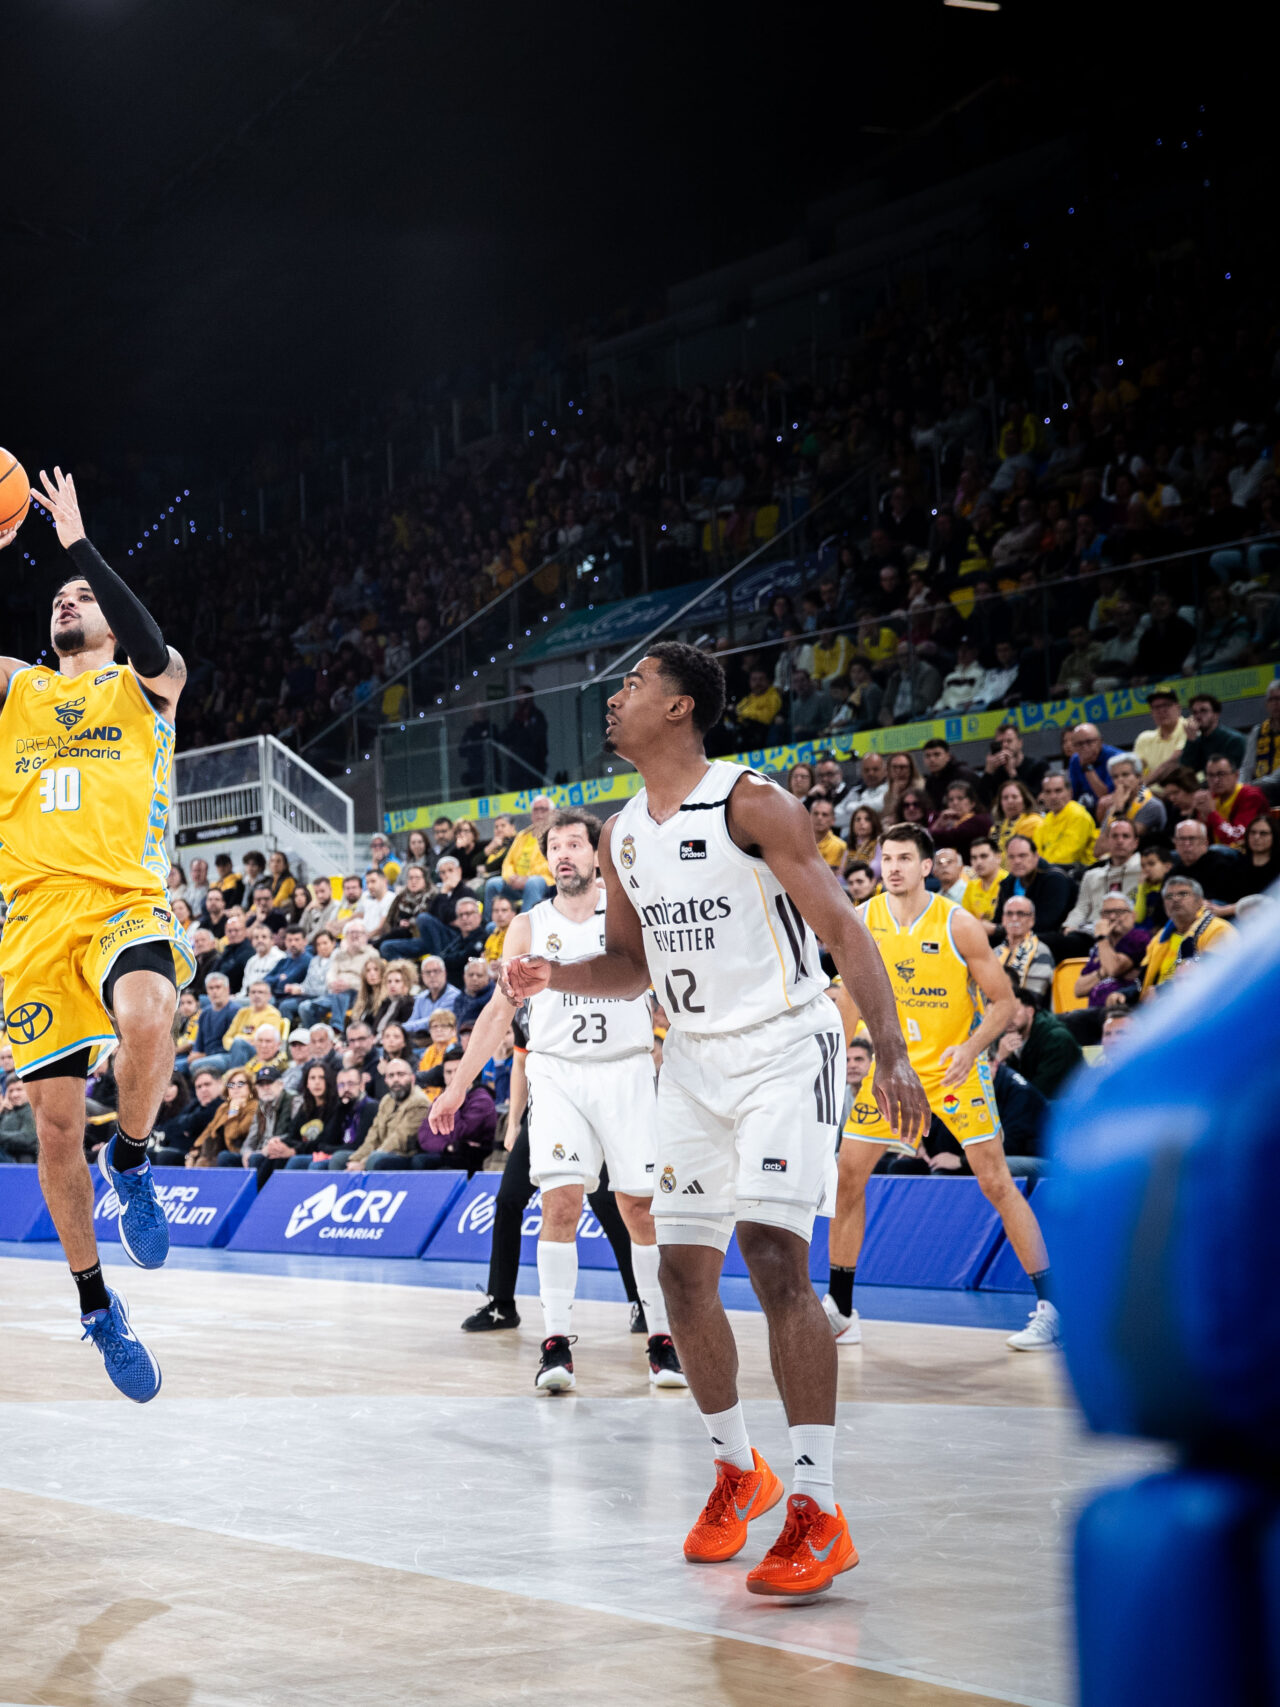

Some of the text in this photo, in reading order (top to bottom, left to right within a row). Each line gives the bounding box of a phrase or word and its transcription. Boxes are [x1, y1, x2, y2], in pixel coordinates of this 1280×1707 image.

[39, 767, 81, 813] 30
[641, 896, 731, 928] mirates
[669, 927, 716, 952] ETTER
[572, 1013, 607, 1043] 23
[763, 1160, 782, 1171] acb
[318, 1226, 384, 1240] CANARIAS
